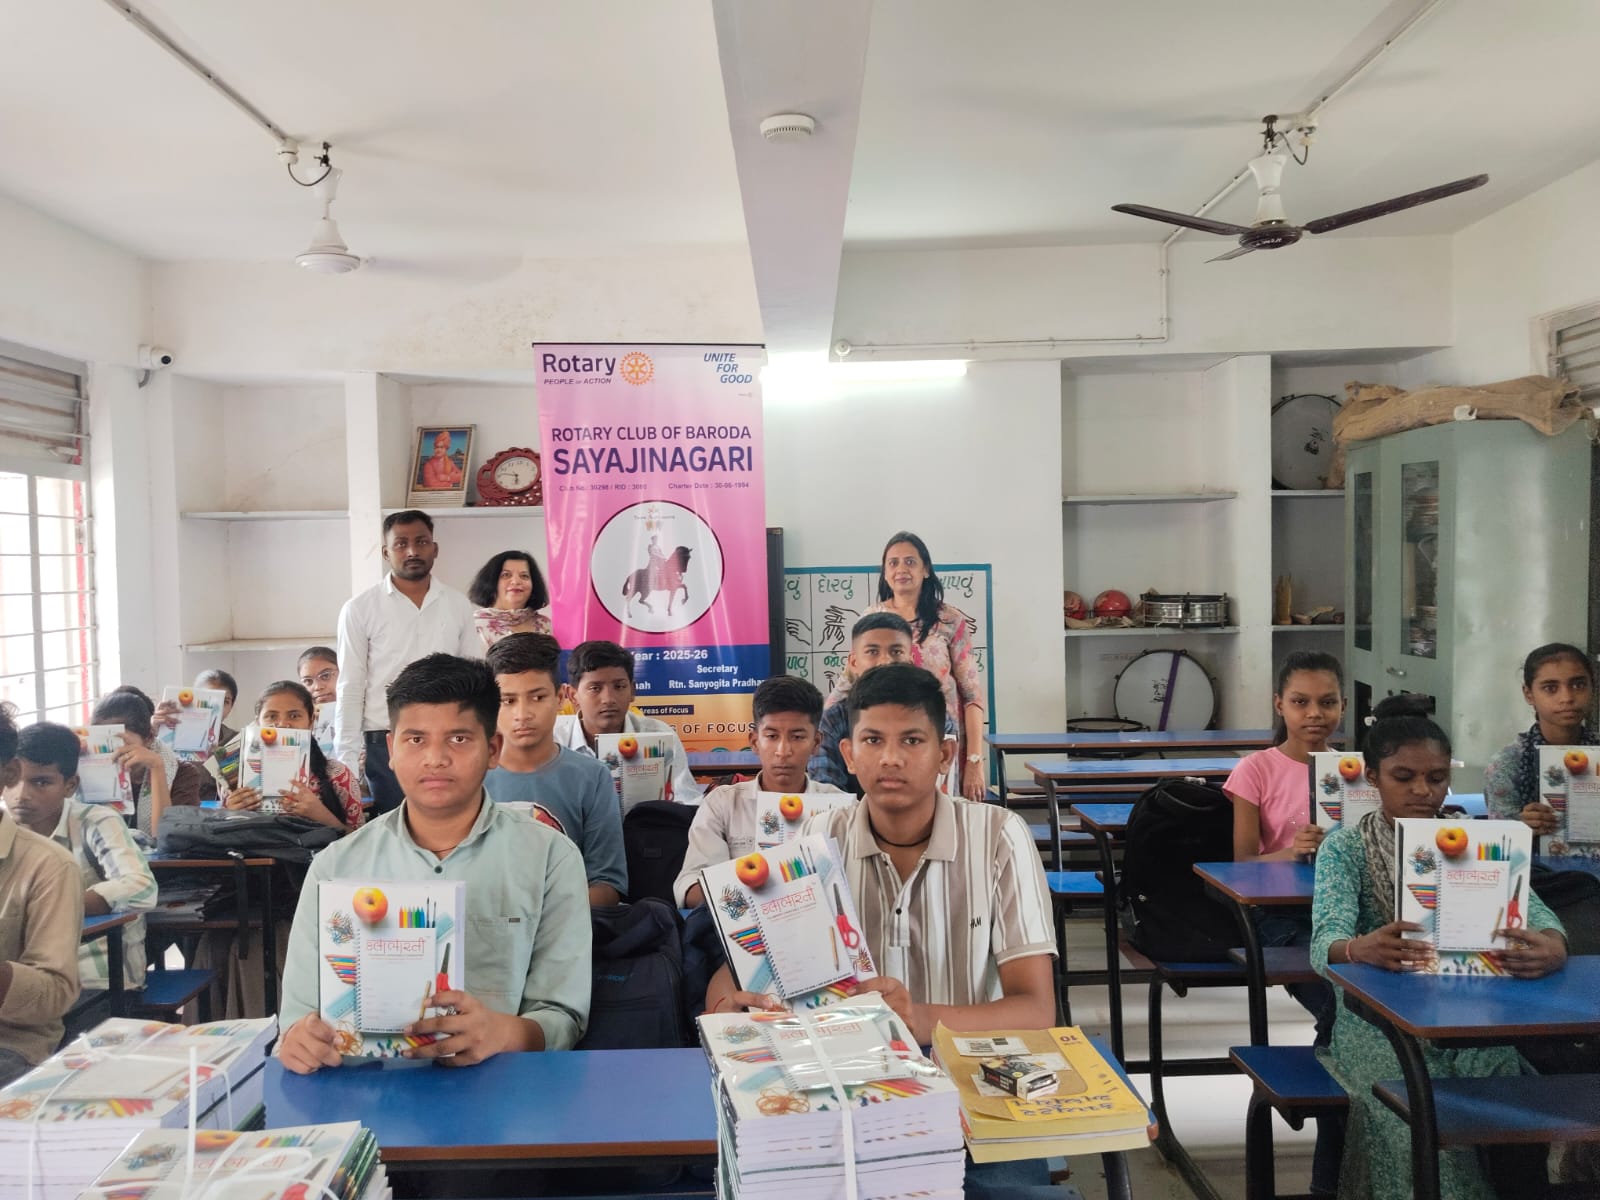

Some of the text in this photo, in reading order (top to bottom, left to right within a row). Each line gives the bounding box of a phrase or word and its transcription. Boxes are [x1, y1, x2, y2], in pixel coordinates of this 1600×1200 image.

[703, 352, 737, 362] UNITE
[542, 353, 616, 376] Rotary
[716, 363, 739, 373] FOR
[720, 374, 753, 384] GOOD
[552, 426, 752, 442] ROTARY CLUB OF BARODA
[553, 446, 752, 475] SAYAJINAGARI
[631, 651, 654, 660] ear
[663, 650, 708, 660] 2025-26
[696, 664, 739, 674] Secretary
[668, 679, 686, 689] Rtn.
[688, 679, 730, 690] Sanyogita
[683, 724, 701, 734] OF
[707, 722, 757, 733] FOCUS
